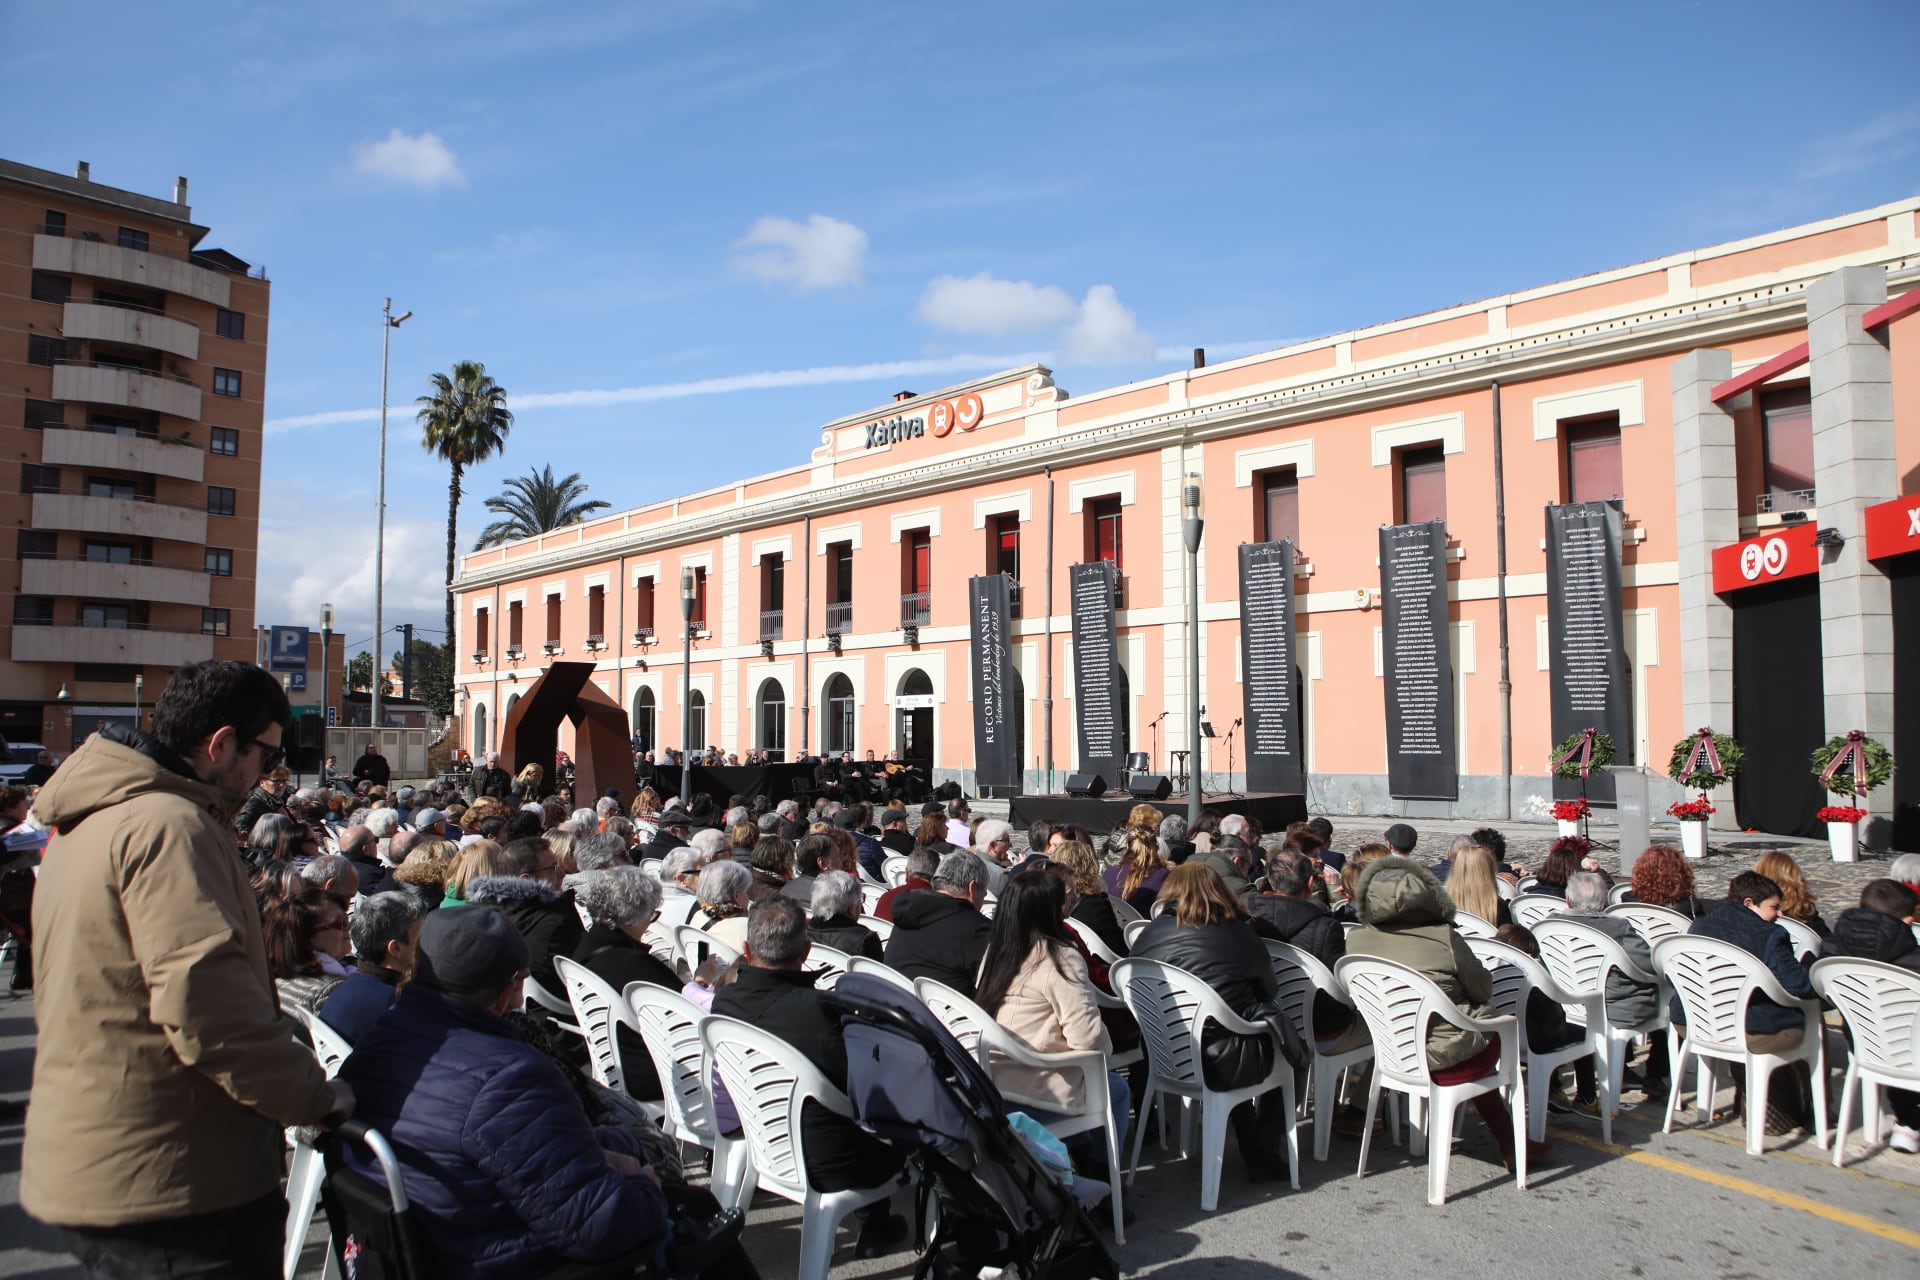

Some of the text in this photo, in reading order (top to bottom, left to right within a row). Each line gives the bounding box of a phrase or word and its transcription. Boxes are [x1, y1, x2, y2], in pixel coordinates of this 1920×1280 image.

[864, 415, 924, 449] Xàtiva
[991, 611, 999, 630] 1939
[280, 631, 300, 652] P
[295, 675, 303, 684] P
[980, 595, 994, 743] RECORD PERMANENT
